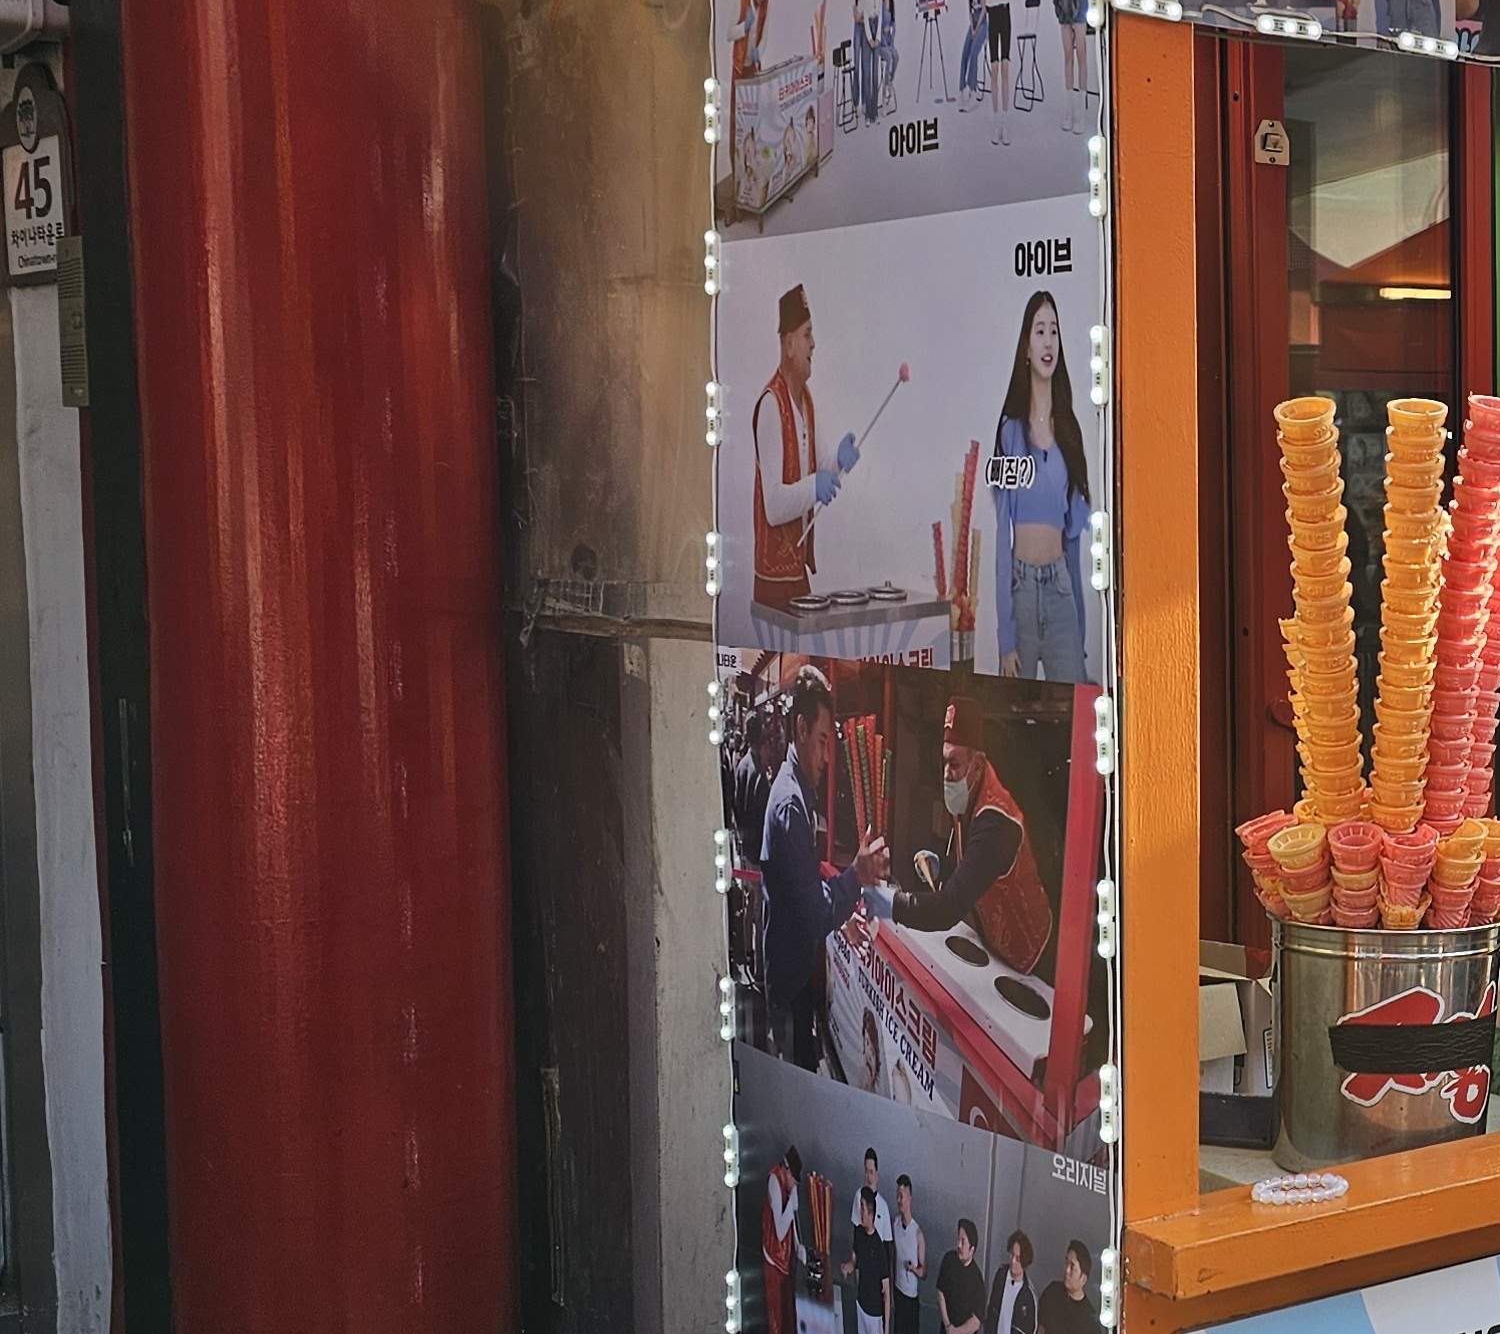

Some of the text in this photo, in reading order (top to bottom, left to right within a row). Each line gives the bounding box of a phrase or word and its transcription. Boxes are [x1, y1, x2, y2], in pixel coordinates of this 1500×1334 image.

[889, 118, 939, 158] 아이브
[15, 155, 52, 220] 45
[11, 222, 65, 248] 차이나타운로
[1014, 237, 1073, 277] 아이브
[864, 950, 938, 1071] 키아이스크림
[1052, 1154, 1107, 1195] 오리지널
